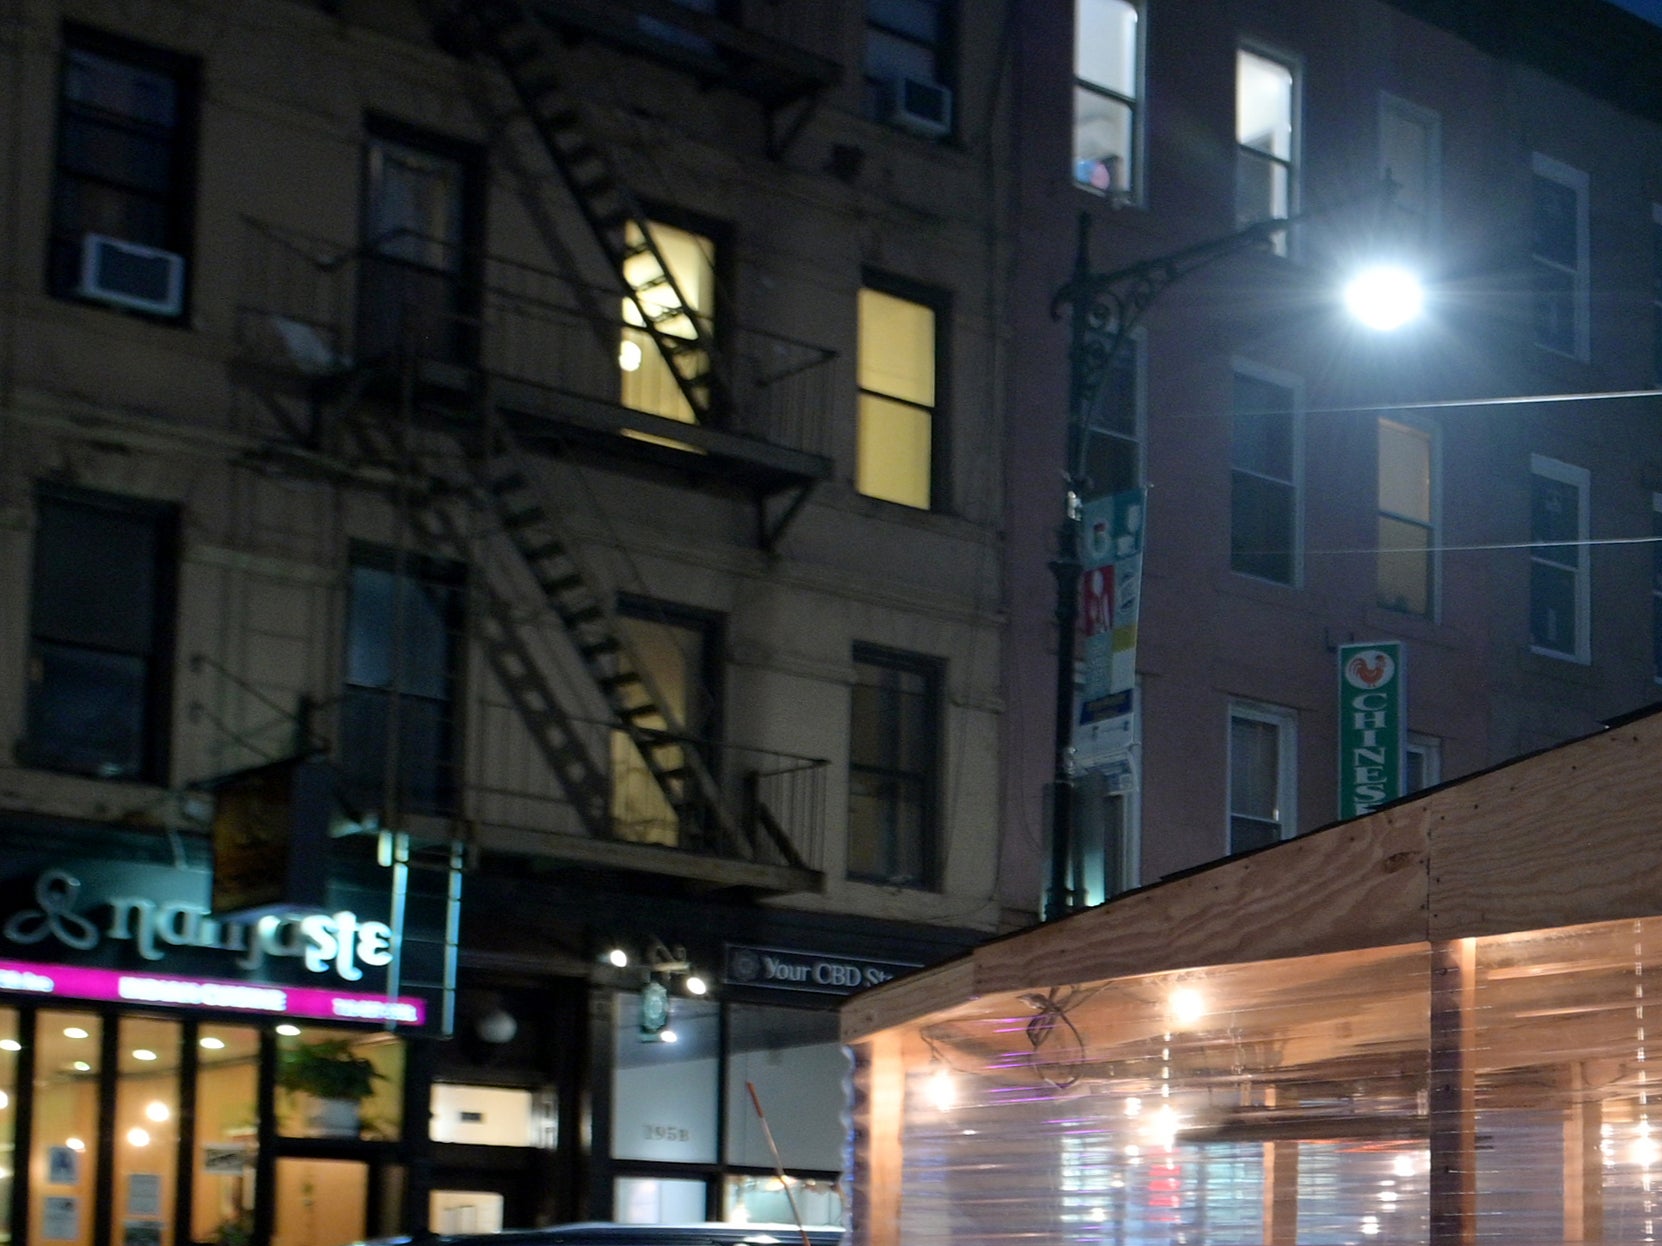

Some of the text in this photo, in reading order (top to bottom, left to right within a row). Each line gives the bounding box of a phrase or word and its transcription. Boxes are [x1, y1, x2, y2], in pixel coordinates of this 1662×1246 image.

[764, 957, 895, 988] Your CBD St
